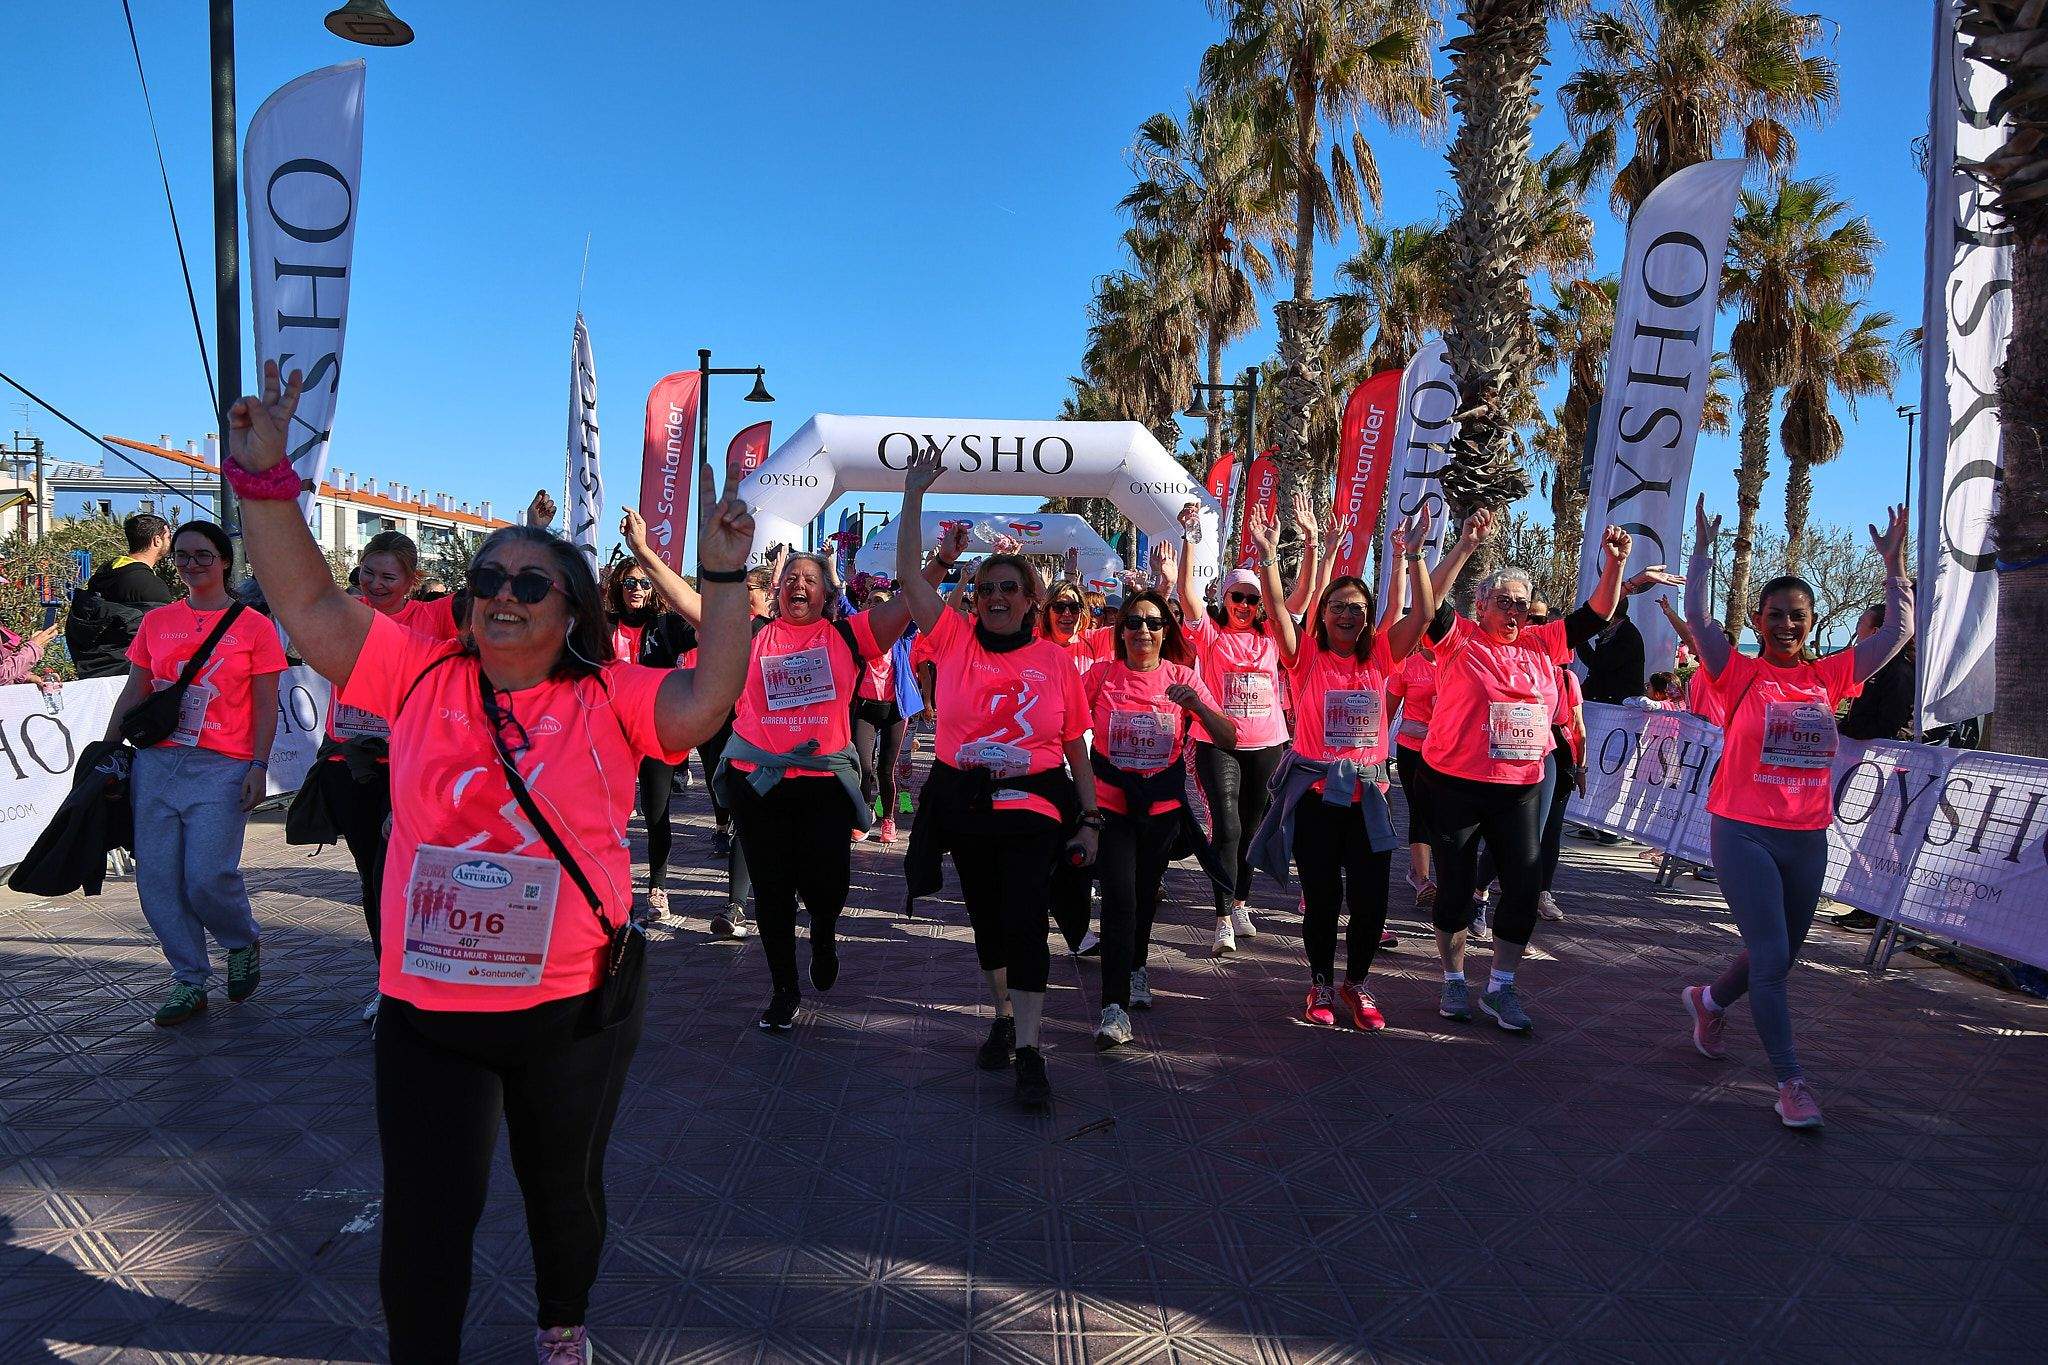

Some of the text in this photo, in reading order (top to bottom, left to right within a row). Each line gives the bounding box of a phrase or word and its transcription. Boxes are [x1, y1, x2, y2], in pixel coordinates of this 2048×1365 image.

[266, 158, 351, 492] YSHO
[1597, 231, 1709, 594] OYSHO
[657, 402, 685, 516] Santander
[877, 432, 1074, 475] OYSHO
[1344, 404, 1386, 528] Santander
[759, 474, 819, 488] OYSHO
[1129, 481, 1188, 495] OYSHO
[160, 632, 189, 640] OYSHO
[972, 660, 1000, 674] OYSHO
[787, 674, 812, 686] 016
[1240, 691, 1258, 700] 016
[761, 716, 829, 724] CARRERA DE LA MUJER
[1346, 715, 1370, 726] 016
[1512, 728, 1534, 738] 016
[1791, 731, 1821, 743] 016
[1131, 736, 1155, 748] 016
[1599, 727, 1721, 795] OYSH
[1753, 773, 1786, 785] CARRERA
[1787, 777, 1796, 785] DE
[1797, 778, 1807, 786] LA
[1833, 761, 2048, 864] OYSH
[455, 868, 509, 886] ASTURIANA
[1874, 856, 2002, 904] WWW.OYSHO.COM
[448, 909, 505, 935] 016
[458, 937, 480, 948] 407
[418, 943, 443, 955] CARRERA
[443, 948, 451, 956] DE
[452, 949, 462, 957] LA
[463, 951, 488, 961] MUJER
[493, 954, 526, 963] VALENCIA
[415, 957, 526, 979] OYSHO Santander
